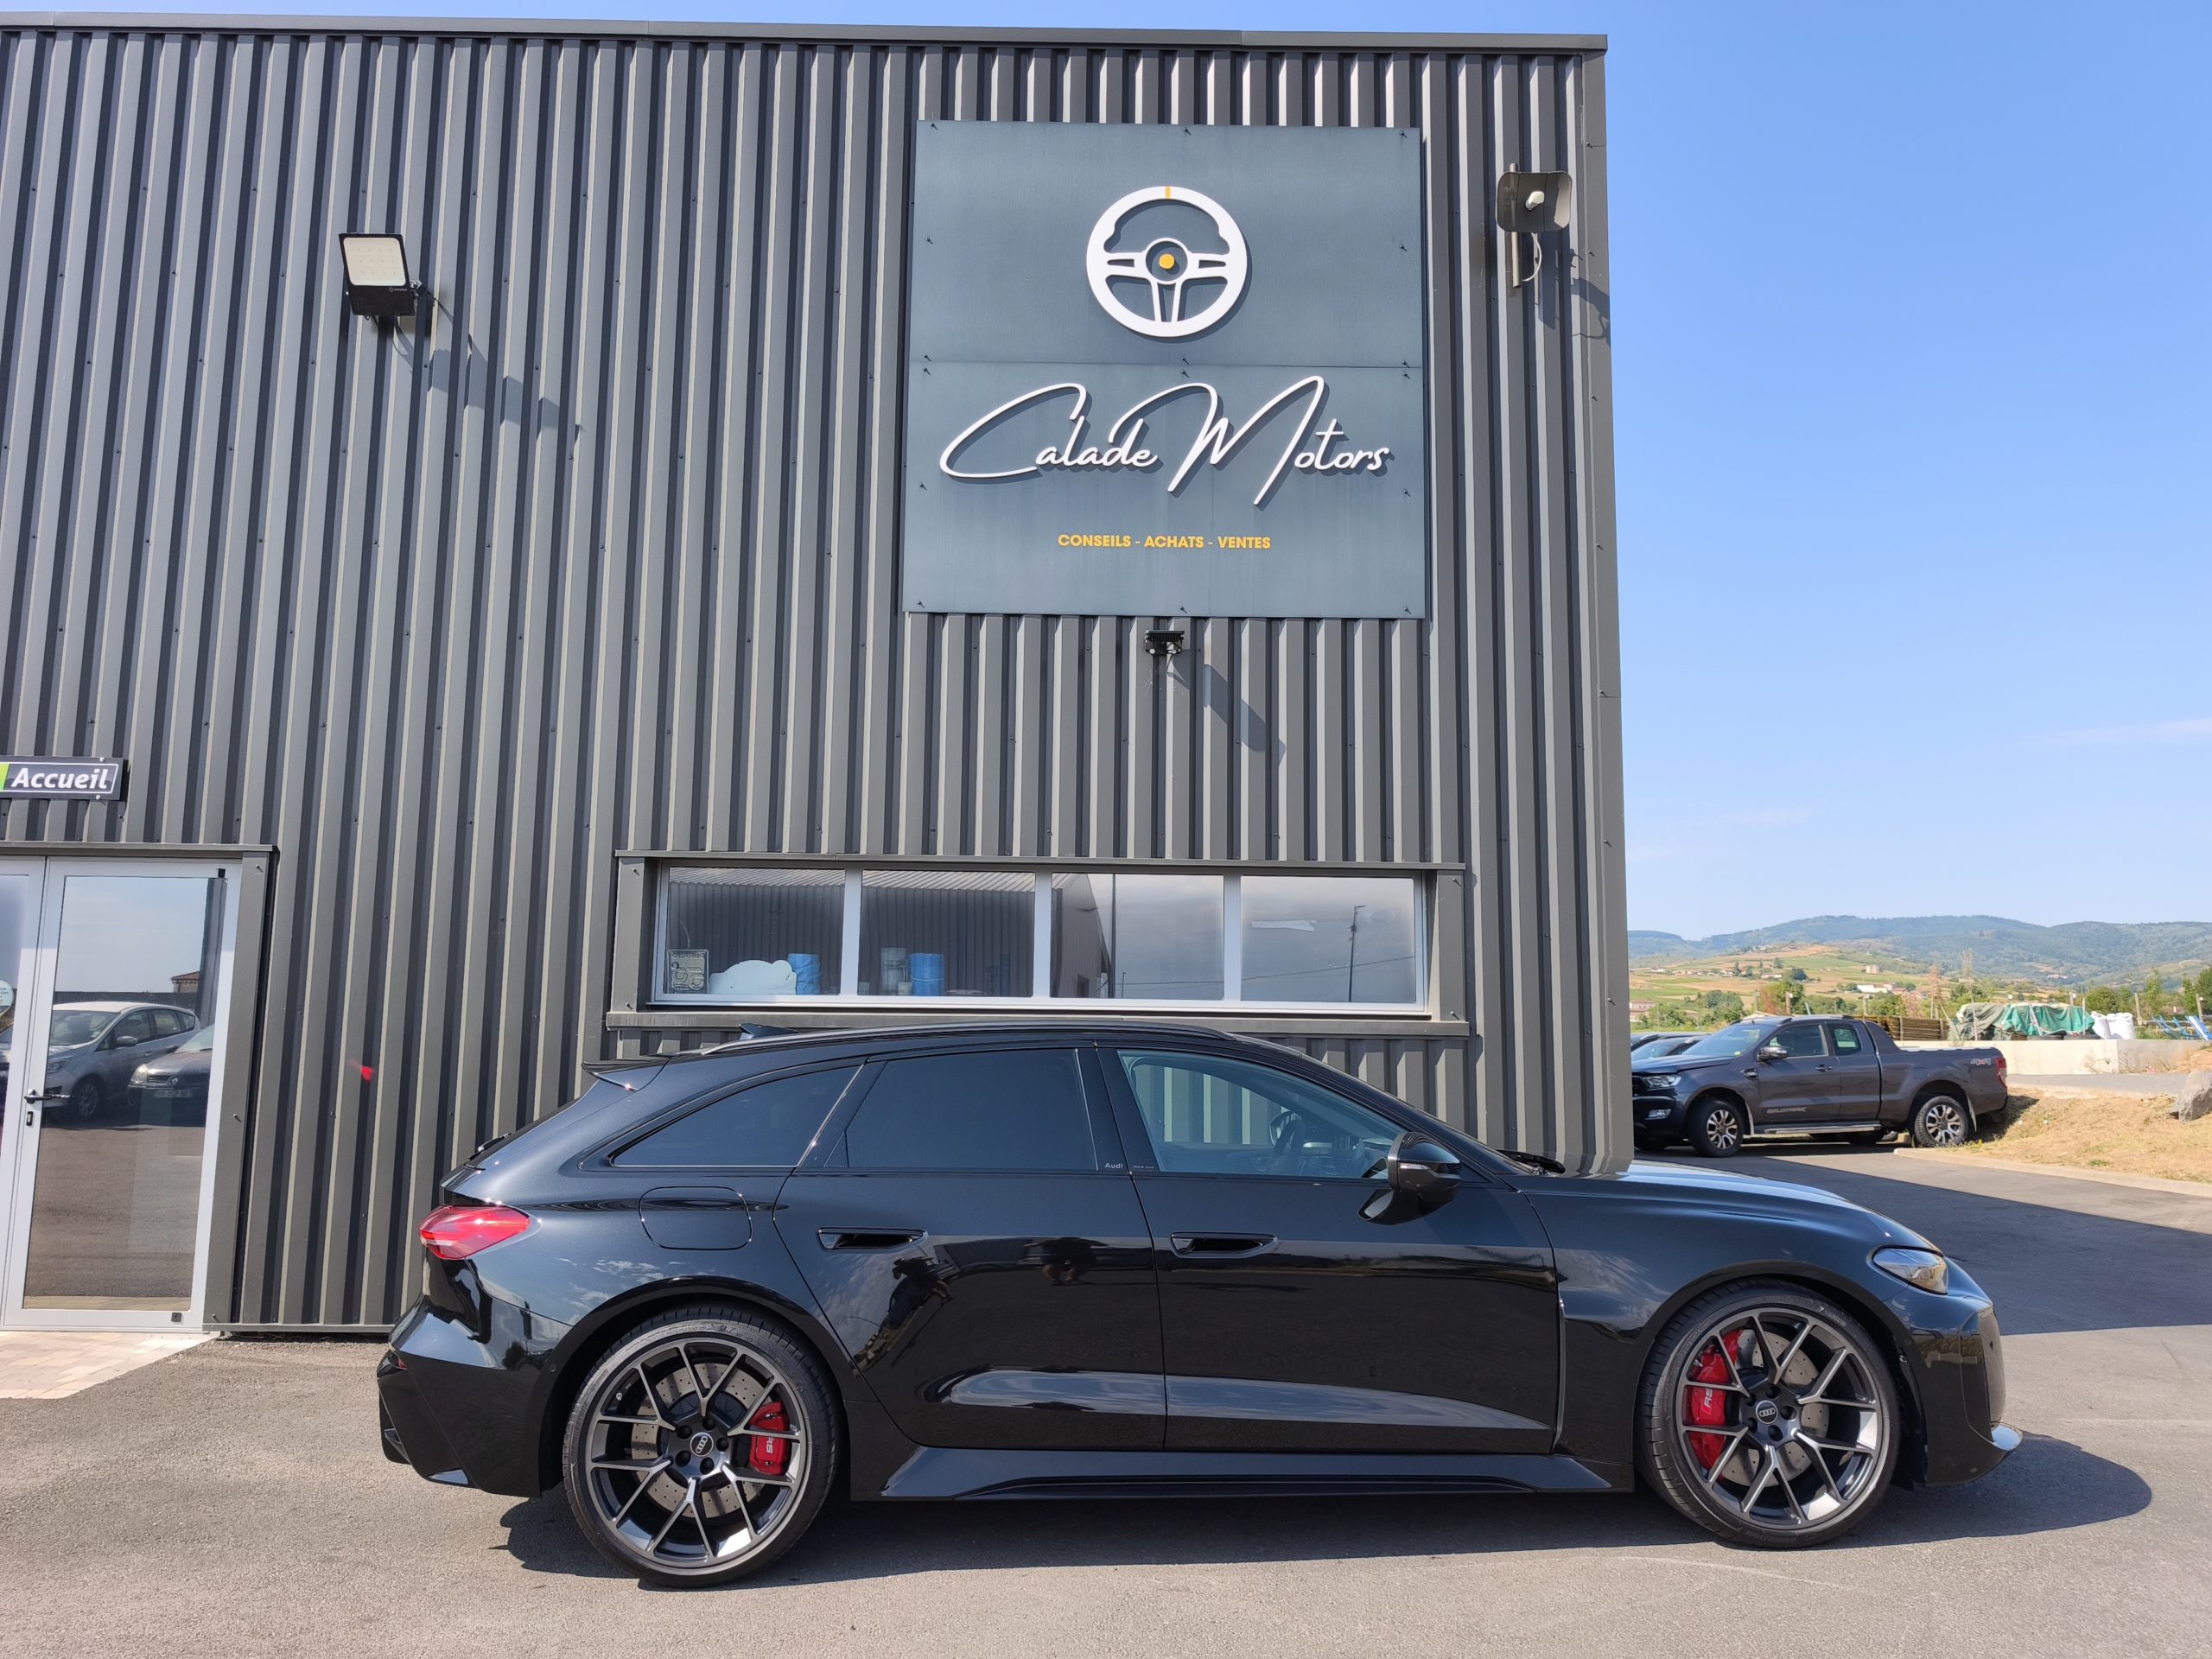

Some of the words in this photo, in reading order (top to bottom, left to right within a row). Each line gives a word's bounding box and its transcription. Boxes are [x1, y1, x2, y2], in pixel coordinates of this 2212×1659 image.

[939, 382, 1158, 479] Calade
[1108, 374, 1390, 507] Motors
[1057, 533, 1132, 548] CONSEILS
[1143, 534, 1205, 549] ACHATS
[1217, 536, 1271, 550] VENTES
[10, 767, 109, 789] Accueil
[1703, 1387, 1713, 1408] RS
